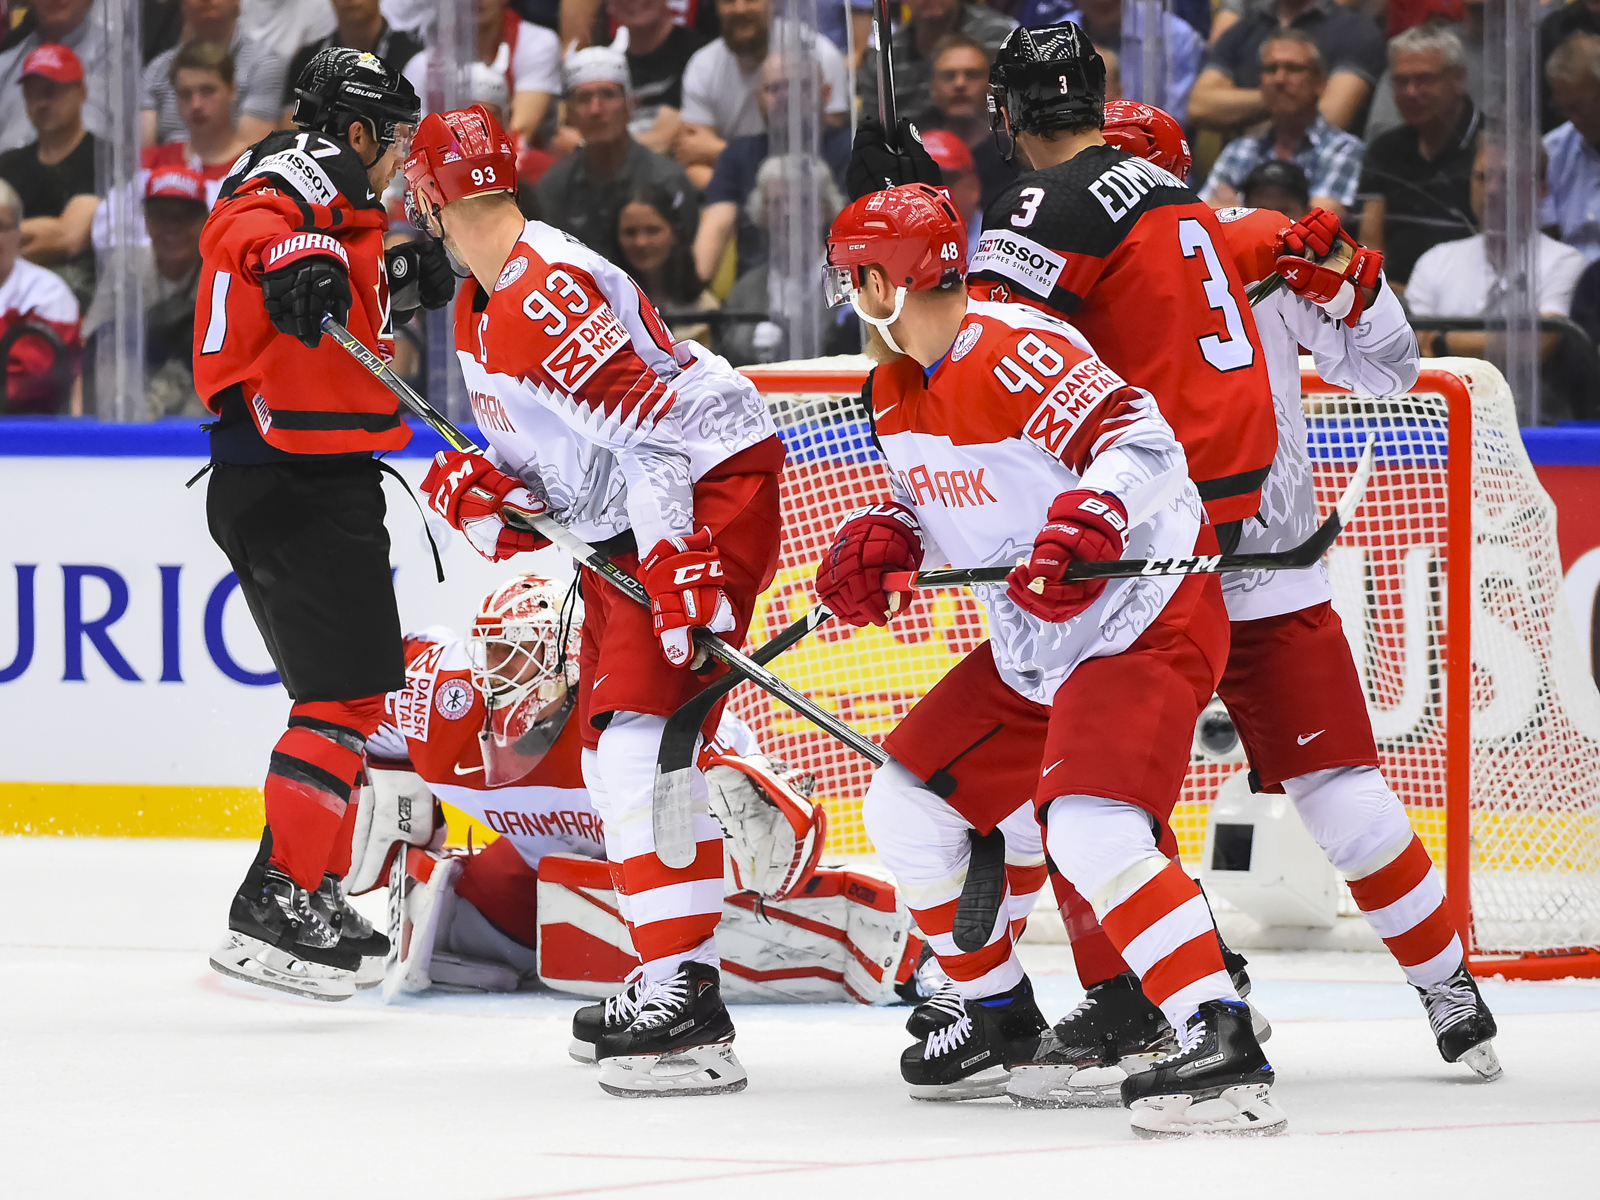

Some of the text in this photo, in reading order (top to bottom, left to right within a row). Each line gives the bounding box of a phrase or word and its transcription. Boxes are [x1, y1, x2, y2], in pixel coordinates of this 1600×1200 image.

[345, 86, 383, 100] BAUER
[1059, 75, 1067, 94] 3
[294, 133, 342, 159] 17
[278, 153, 331, 200] TISSOT
[471, 166, 496, 186] 93
[1010, 187, 1046, 228] 3
[849, 243, 866, 251] CCM
[940, 241, 959, 262] 48
[993, 238, 1060, 277] TISSOT
[1035, 274, 1052, 287] 1853
[1353, 254, 1365, 281] CCM
[523, 269, 589, 336] 93
[1178, 217, 1254, 372] 3
[993, 331, 1065, 395] 48
[1053, 360, 1108, 406] DANSK
[1067, 373, 1121, 418] METAL
[1141, 554, 1223, 576] CCM
[399, 676, 415, 731] METAL
[414, 678, 432, 739] DANSK
[484, 809, 605, 845] DANMARK
